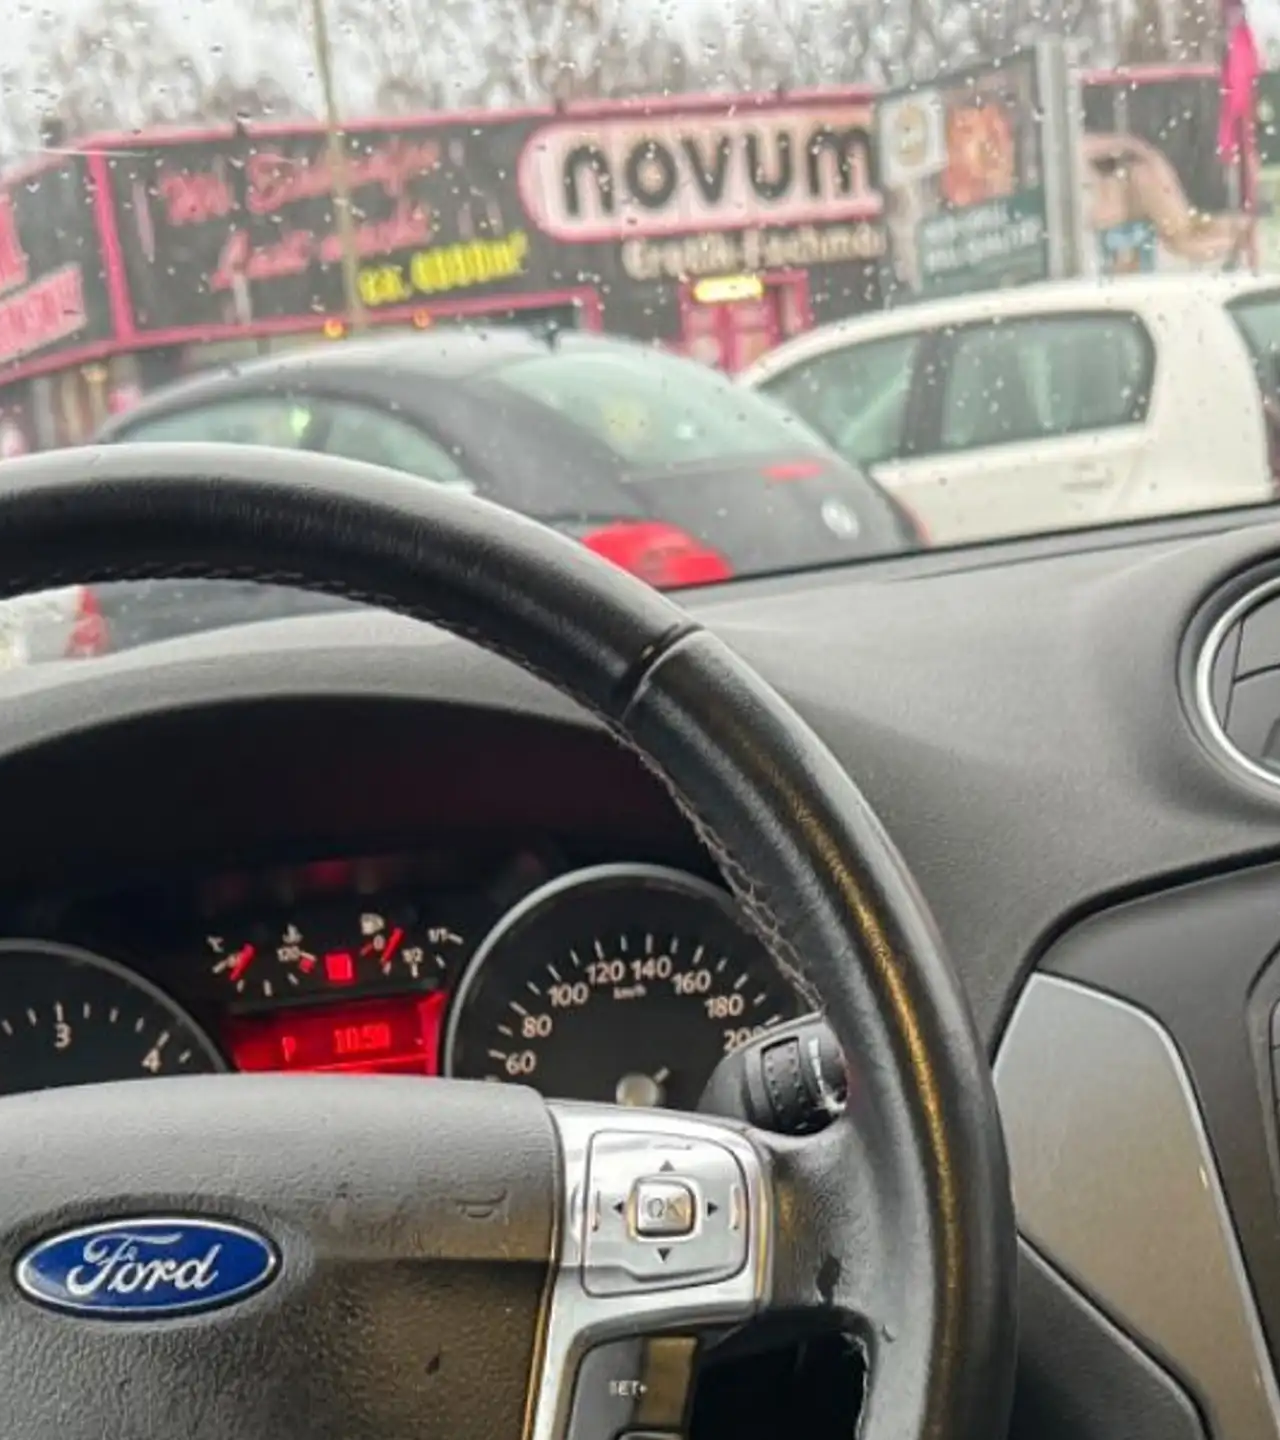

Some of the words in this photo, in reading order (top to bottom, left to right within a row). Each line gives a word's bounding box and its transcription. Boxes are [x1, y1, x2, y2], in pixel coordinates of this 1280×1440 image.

[586, 959, 625, 985] 120
[631, 955, 671, 980] 140
[547, 982, 589, 1007] 100
[672, 970, 712, 995] 160
[704, 994, 744, 1019] 180
[53, 1023, 72, 1050] 3
[522, 1015, 552, 1038] 80
[142, 1047, 162, 1073] 4
[505, 1050, 537, 1075] 60
[66, 1231, 221, 1296] Ford
